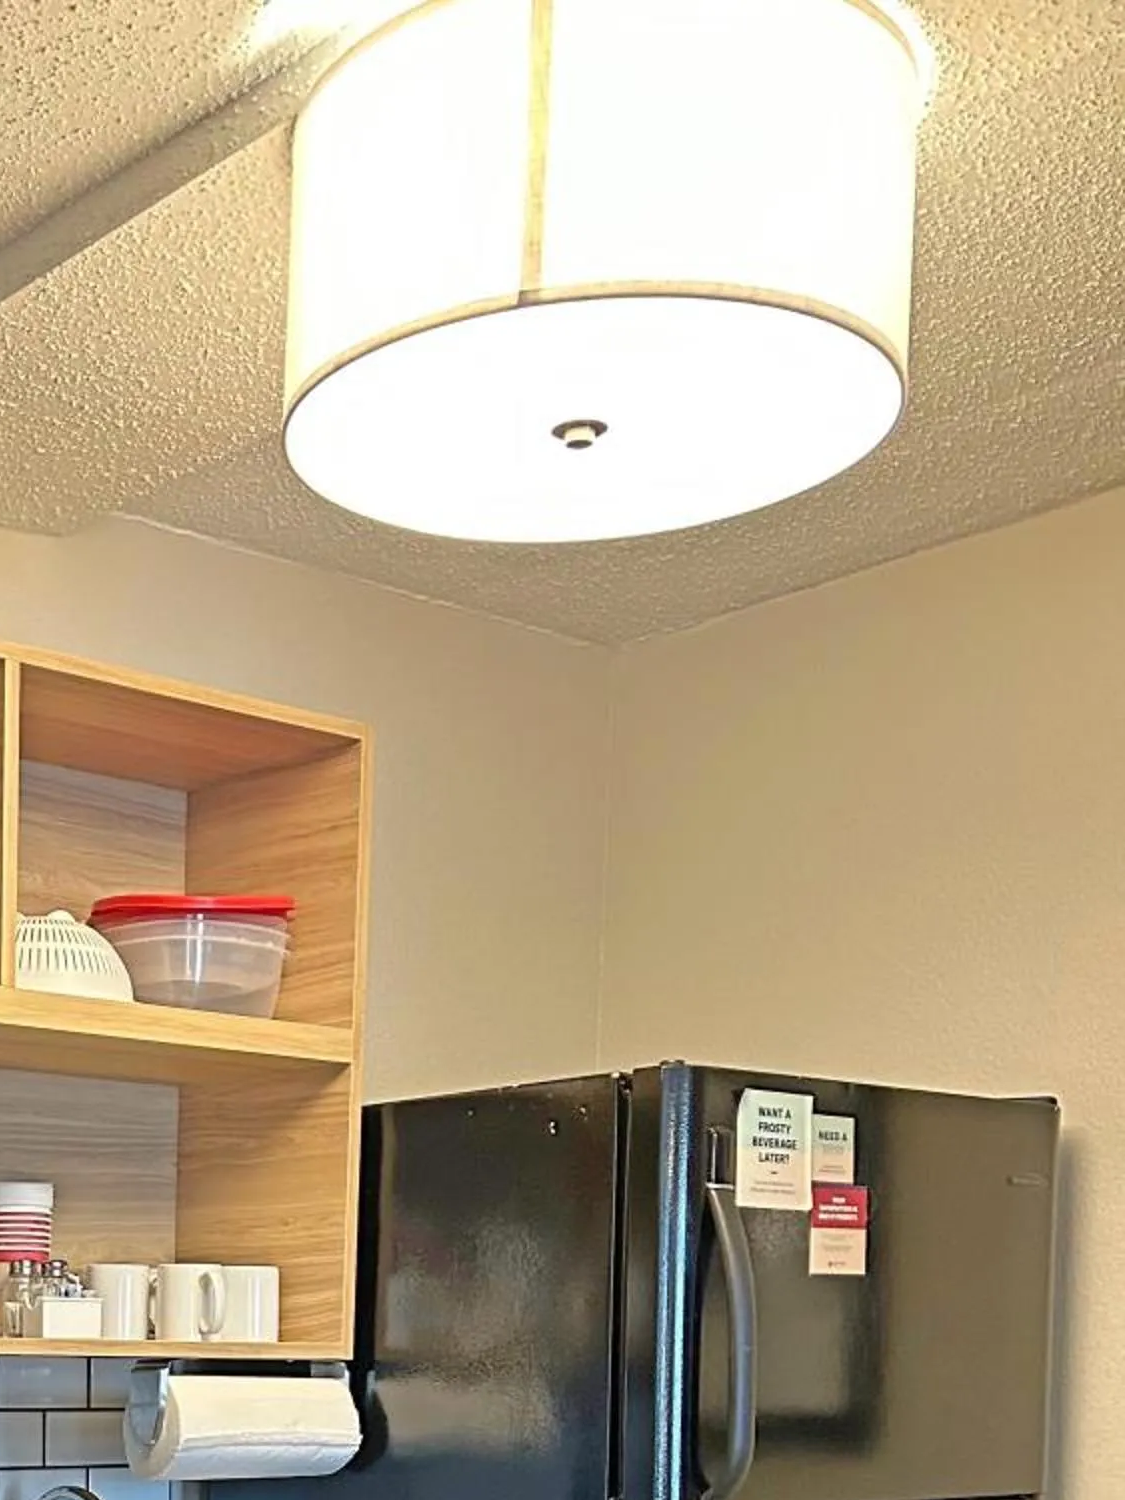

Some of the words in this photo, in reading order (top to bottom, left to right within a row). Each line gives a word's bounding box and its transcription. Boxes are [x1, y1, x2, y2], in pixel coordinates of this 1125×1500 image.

[758, 1106, 783, 1118] WANT
[784, 1108, 792, 1120] A
[758, 1121, 792, 1135] FROSTY
[752, 1135, 798, 1150] BEVERAGE
[818, 1130, 840, 1141] NEED
[842, 1132, 849, 1142] A
[758, 1151, 790, 1165] LATER?
